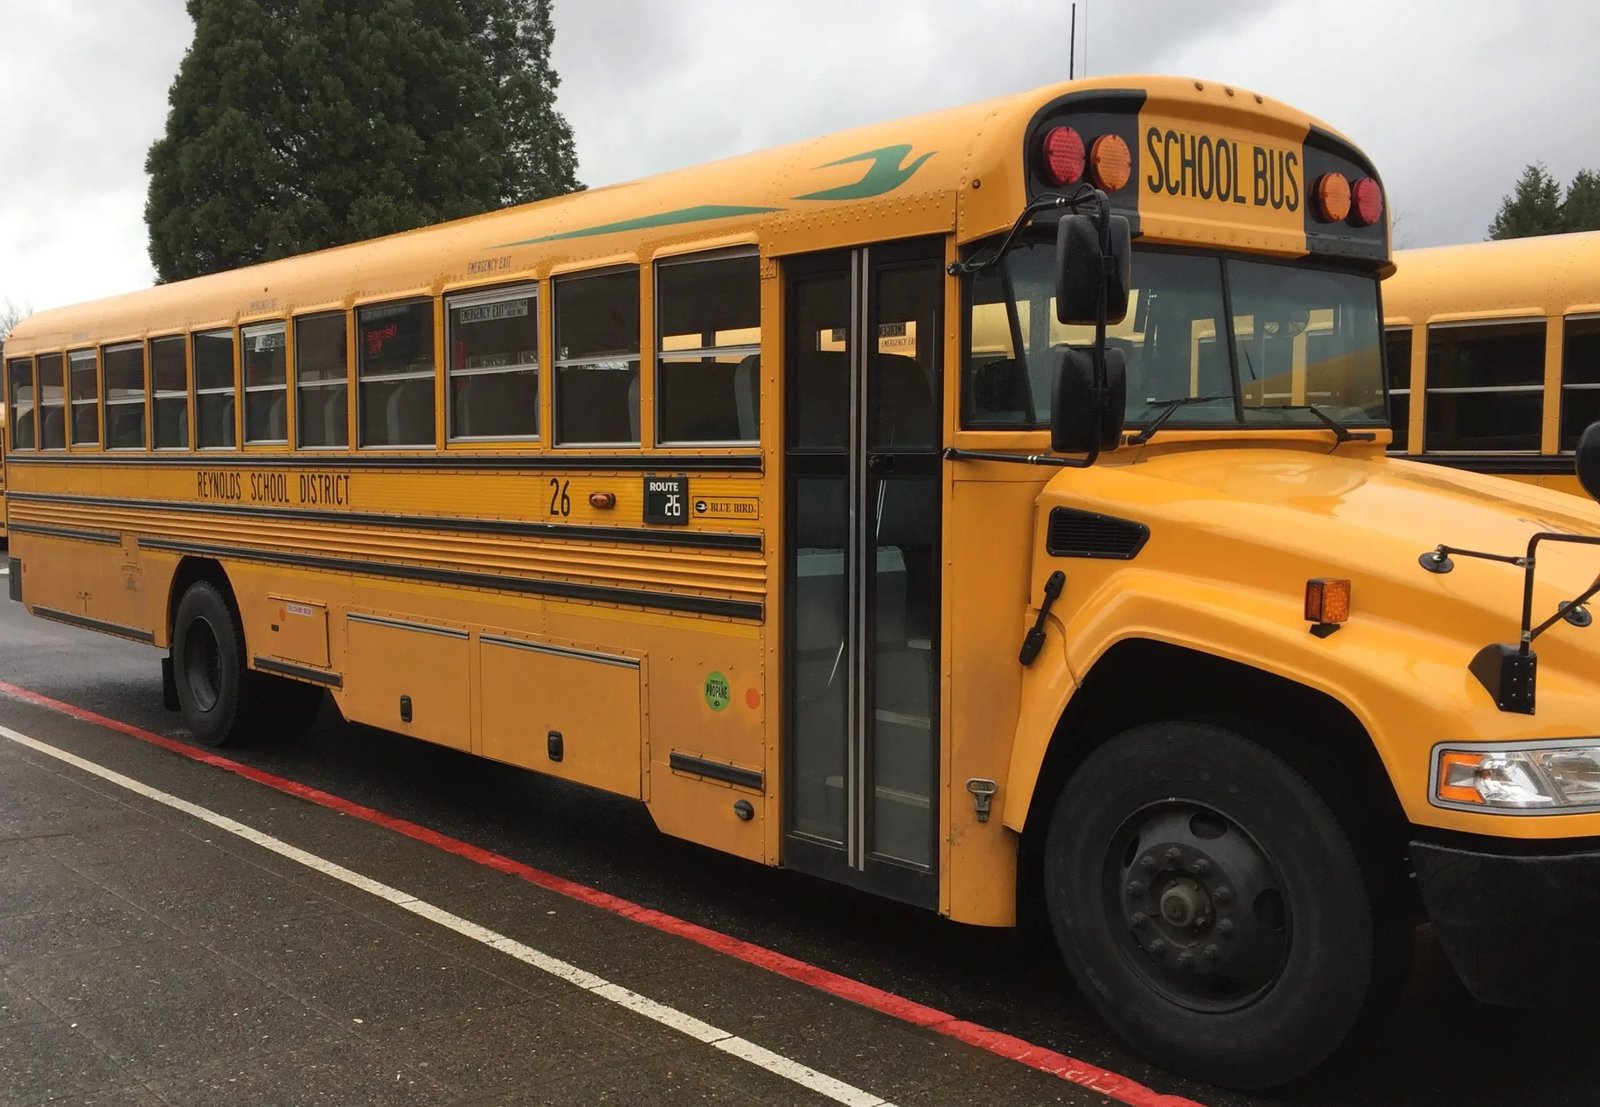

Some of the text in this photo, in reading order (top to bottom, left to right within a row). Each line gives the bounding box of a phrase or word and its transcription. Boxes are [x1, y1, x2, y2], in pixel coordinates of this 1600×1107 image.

[1147, 127, 1299, 212] SCHOOL BUS
[467, 256, 512, 275] EMERGENCY EXIT
[461, 306, 490, 322] EMERGENCY
[492, 304, 504, 318] EXIT
[197, 471, 350, 506] REYNOLDS SCHOOL DISTRICT
[649, 481, 679, 493] ROUTE
[550, 478, 571, 517] 26
[664, 494, 680, 516] 26
[710, 502, 731, 513] BLUE
[706, 684, 727, 699] PROPANE
